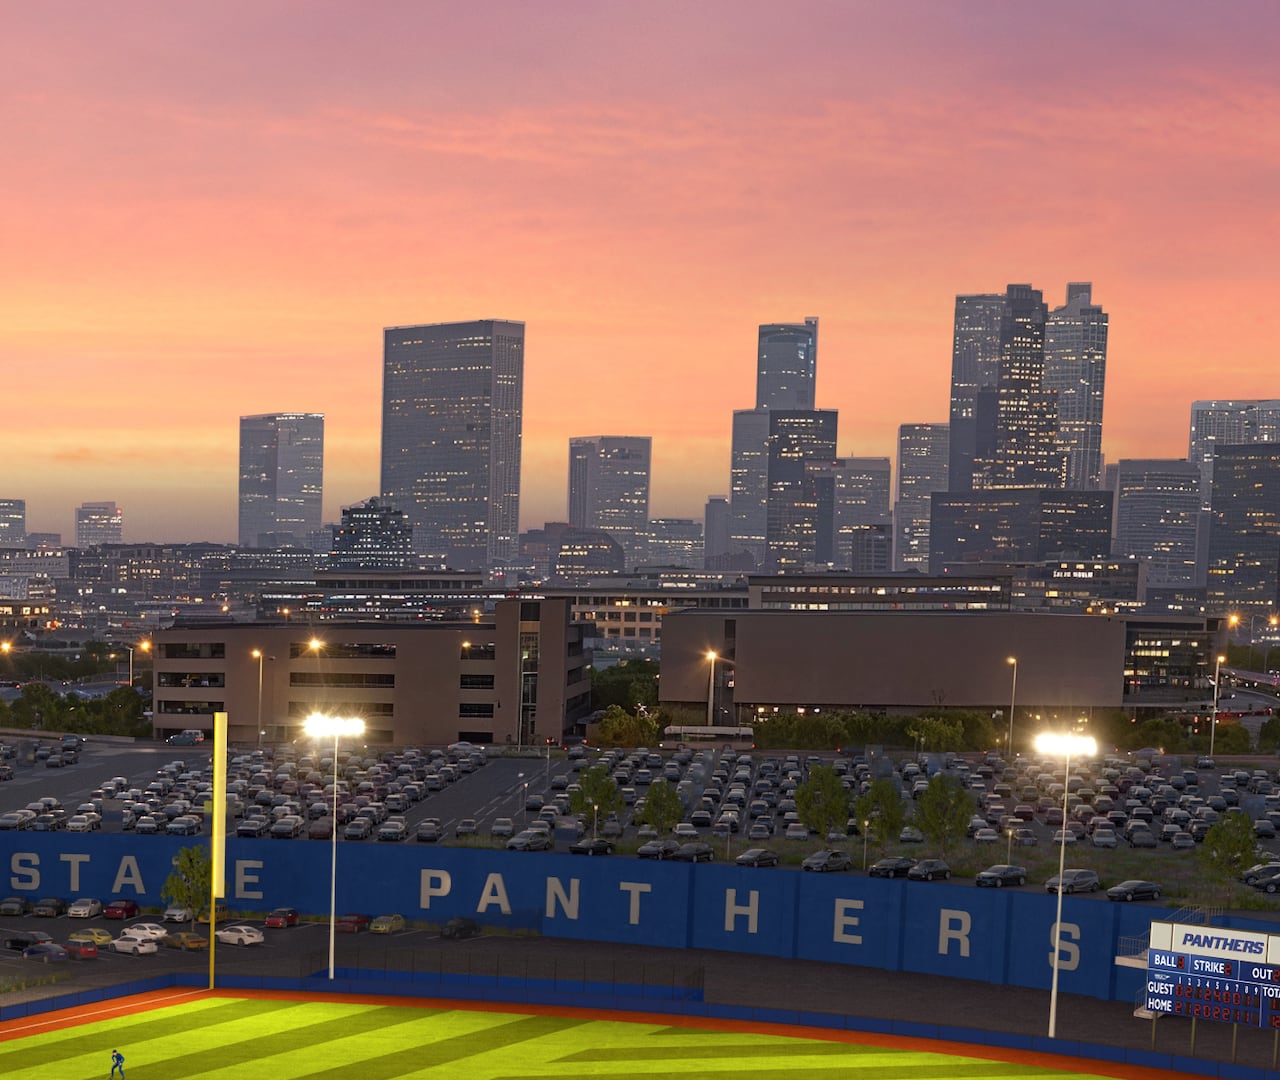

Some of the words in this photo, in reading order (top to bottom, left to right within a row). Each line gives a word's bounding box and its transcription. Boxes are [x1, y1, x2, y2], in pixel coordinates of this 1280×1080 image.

[10, 853, 264, 899] STAE
[420, 868, 1081, 971] PANTHERS
[1182, 933, 1265, 954] PANTHERS
[1154, 954, 1177, 968] BALL
[1194, 960, 1224, 974] STRIKE
[1224, 963, 1232, 976] 2
[1252, 967, 1273, 981] OUT
[1273, 969, 1280, 983] 2
[1148, 981, 1174, 995] GUEST
[1185, 986, 1192, 999] 2
[1204, 988, 1212, 1001] 2
[1148, 997, 1172, 1011] HOME
[1194, 1004, 1201, 1016] 2
[1203, 1005, 1211, 1018] 0
[1213, 1006, 1220, 1019] 2
[1222, 1007, 1230, 1020] 2
